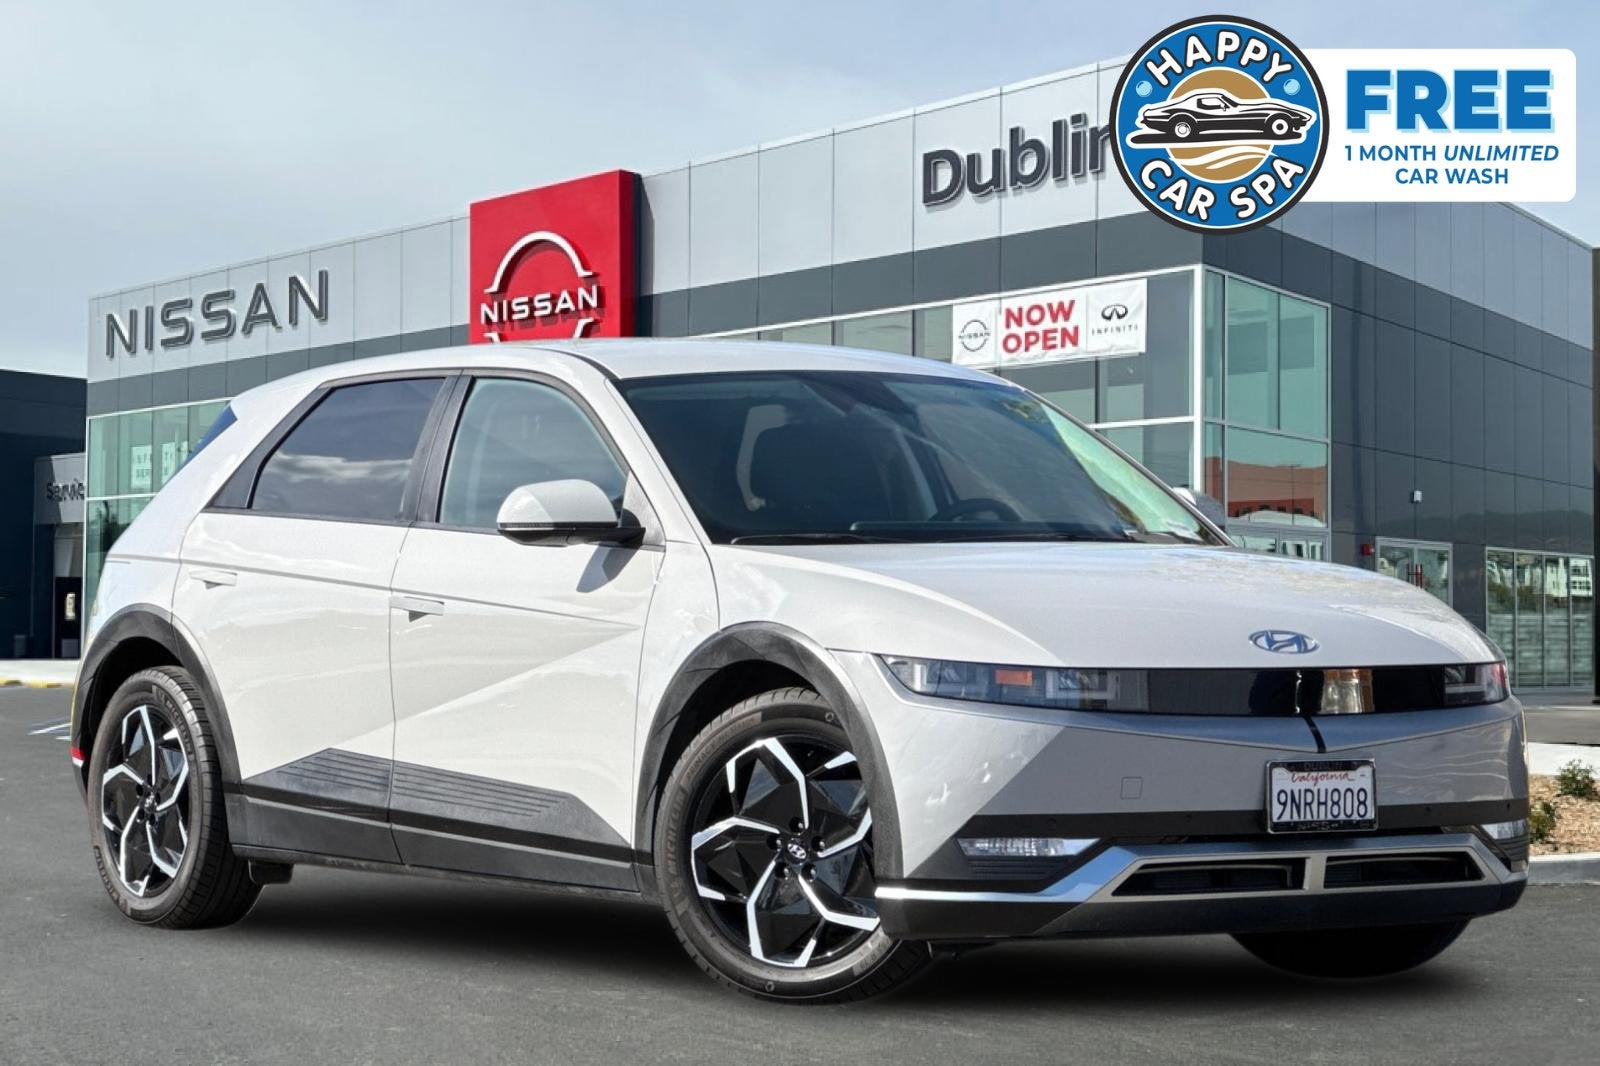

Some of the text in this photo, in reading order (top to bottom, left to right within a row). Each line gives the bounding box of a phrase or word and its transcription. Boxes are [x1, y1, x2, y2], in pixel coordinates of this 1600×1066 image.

[105, 269, 329, 358] NISSAN
[479, 285, 599, 325] NISSAN
[1004, 299, 1076, 329] NOW
[1002, 325, 1079, 354] OPEN
[1091, 324, 1139, 336] INFINITI
[1291, 771, 1355, 787] California
[1276, 787, 1368, 821] 9NRH808
